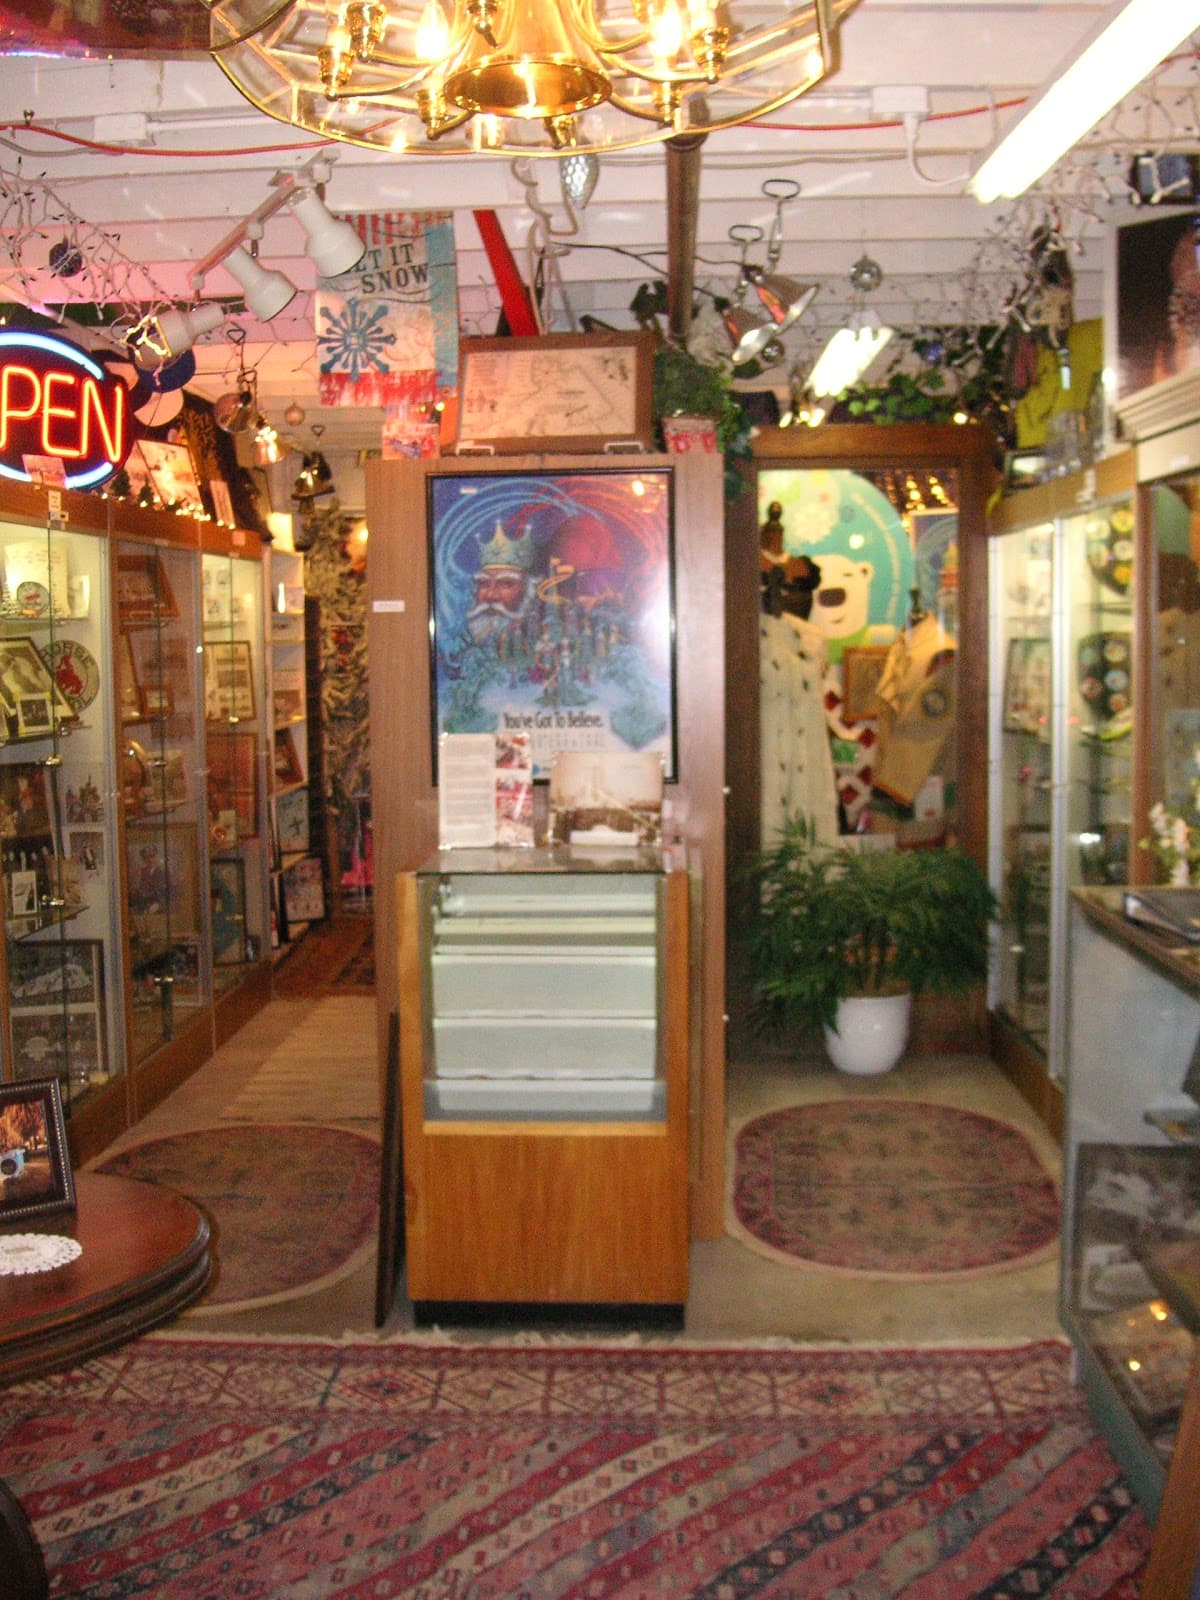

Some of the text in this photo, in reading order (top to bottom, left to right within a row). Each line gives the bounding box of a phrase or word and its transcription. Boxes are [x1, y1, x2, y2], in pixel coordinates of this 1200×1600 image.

[389, 243, 414, 266] IT
[361, 262, 429, 294] SNOW
[0, 365, 123, 462] PEN
